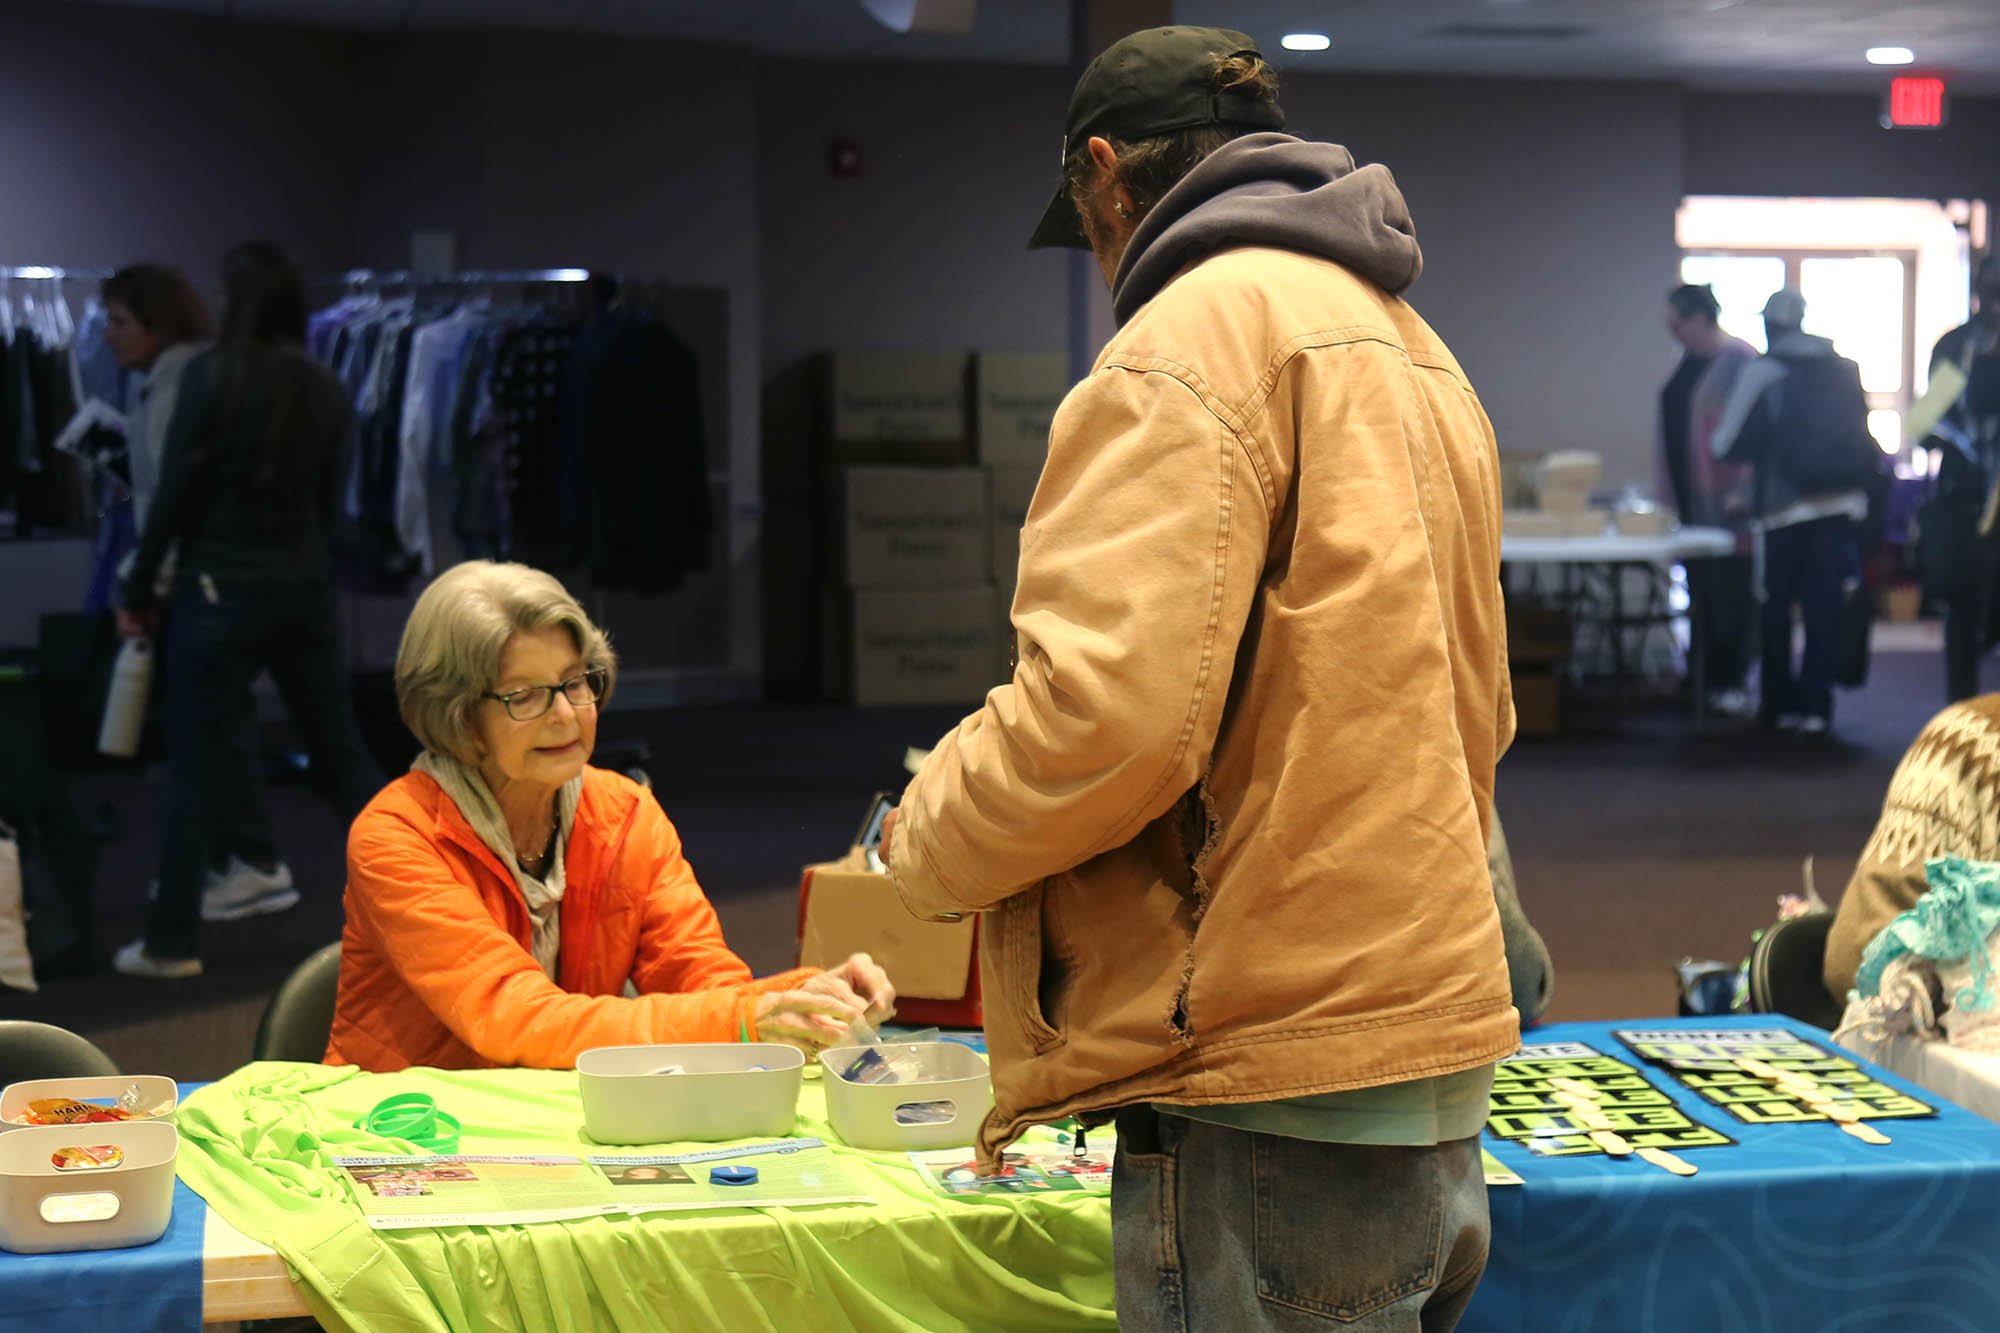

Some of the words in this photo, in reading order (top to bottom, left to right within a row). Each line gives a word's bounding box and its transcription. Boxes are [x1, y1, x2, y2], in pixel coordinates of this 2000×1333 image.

[1895, 80, 1942, 126] EXIT
[1654, 1045, 1813, 1058] LIFE
[1496, 1061, 1622, 1077] IFE
[1742, 1098, 1914, 1117] LIE
